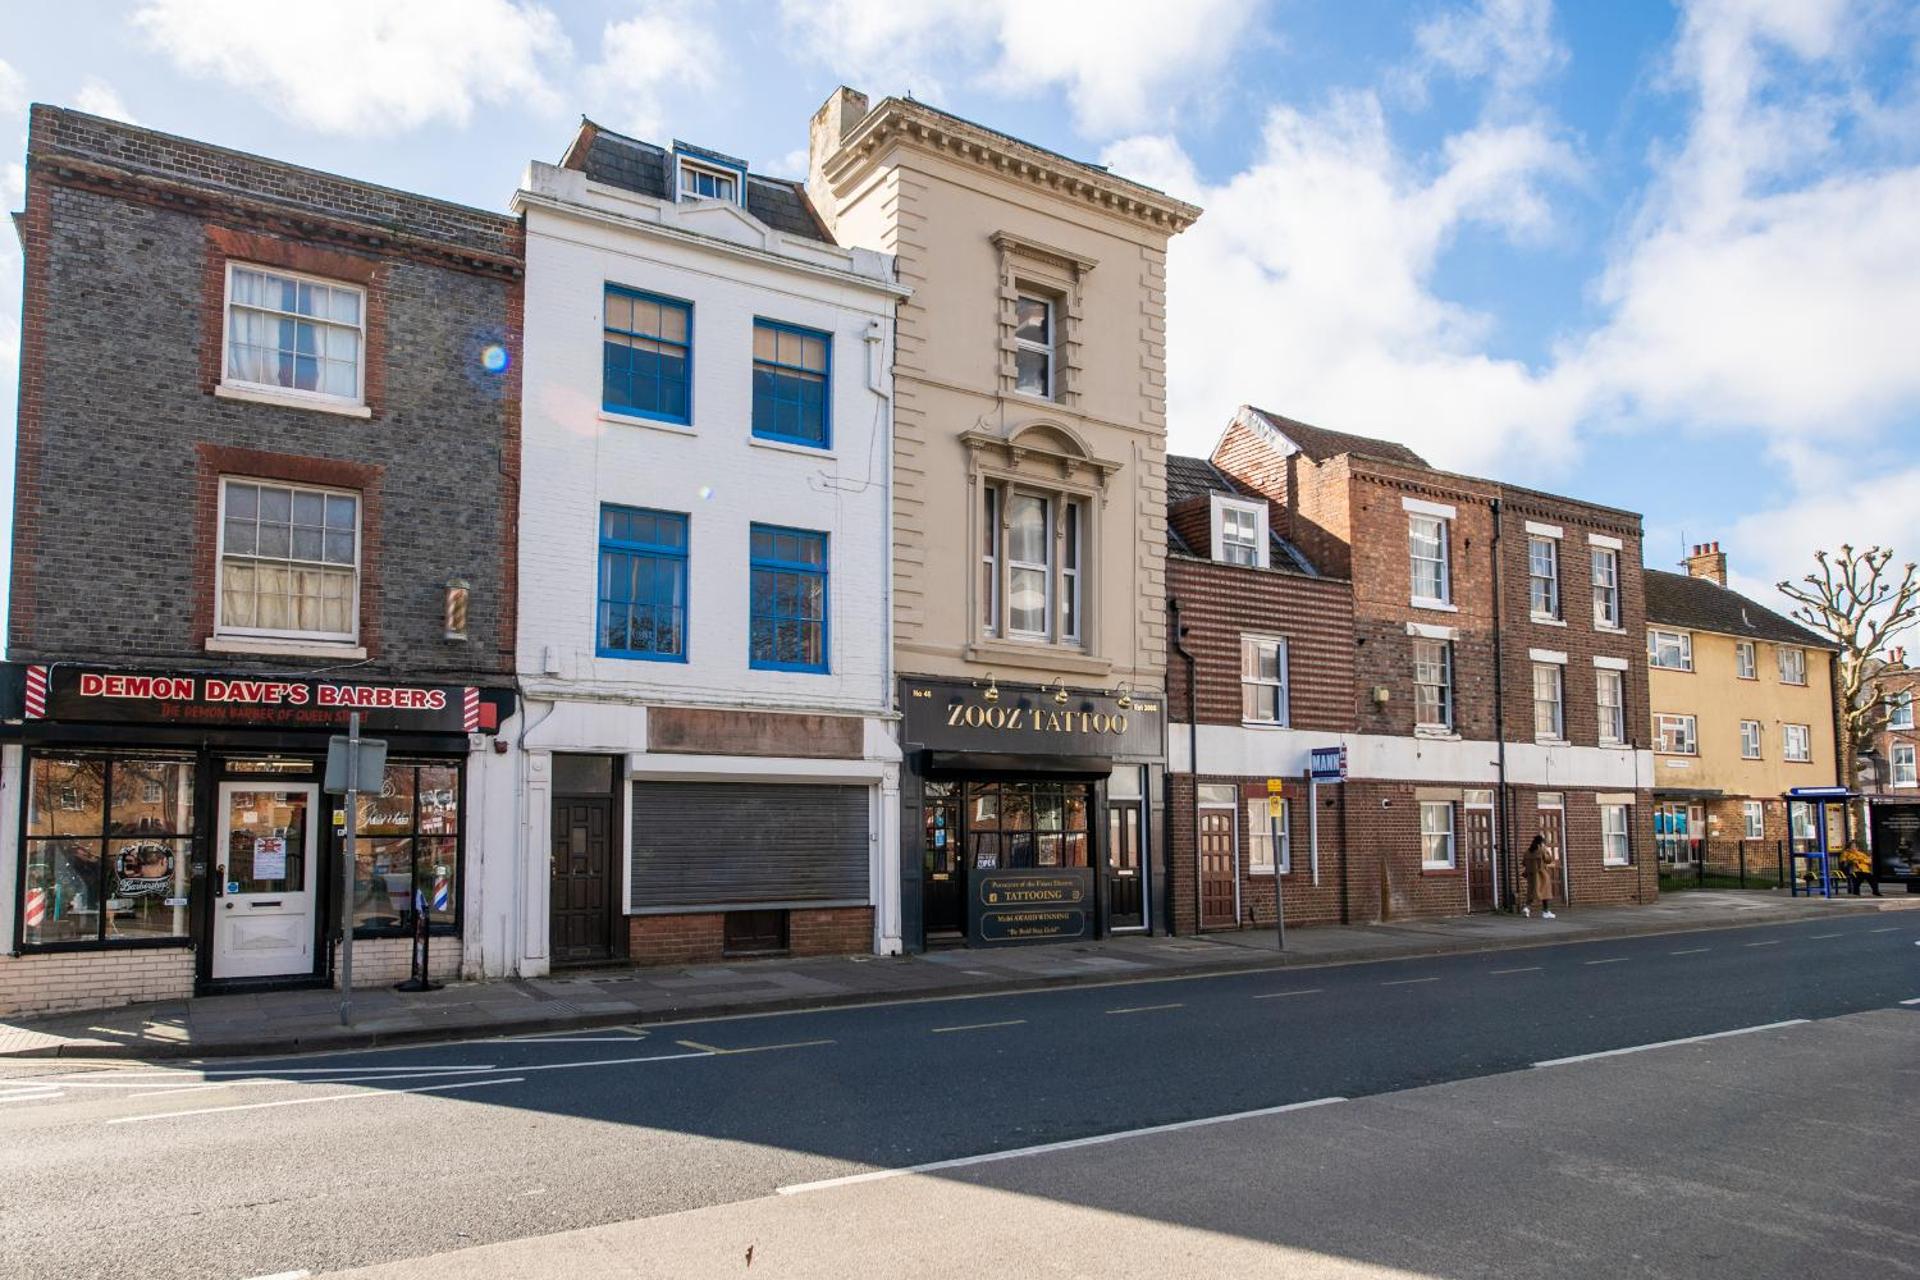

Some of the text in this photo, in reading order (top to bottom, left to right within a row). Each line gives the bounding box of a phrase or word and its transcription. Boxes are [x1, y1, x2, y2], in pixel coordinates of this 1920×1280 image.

[80, 673, 446, 710] DEMON DAVE'S BARBERS
[184, 705, 226, 719] DEMON
[230, 706, 275, 721] BARBER
[278, 708, 294, 721] OF
[296, 709, 333, 722] QUEEN
[947, 703, 1129, 735] ZOOZ TATTOO
[1312, 754, 1339, 771] MANN
[1004, 890, 1062, 901] TATTOOING
